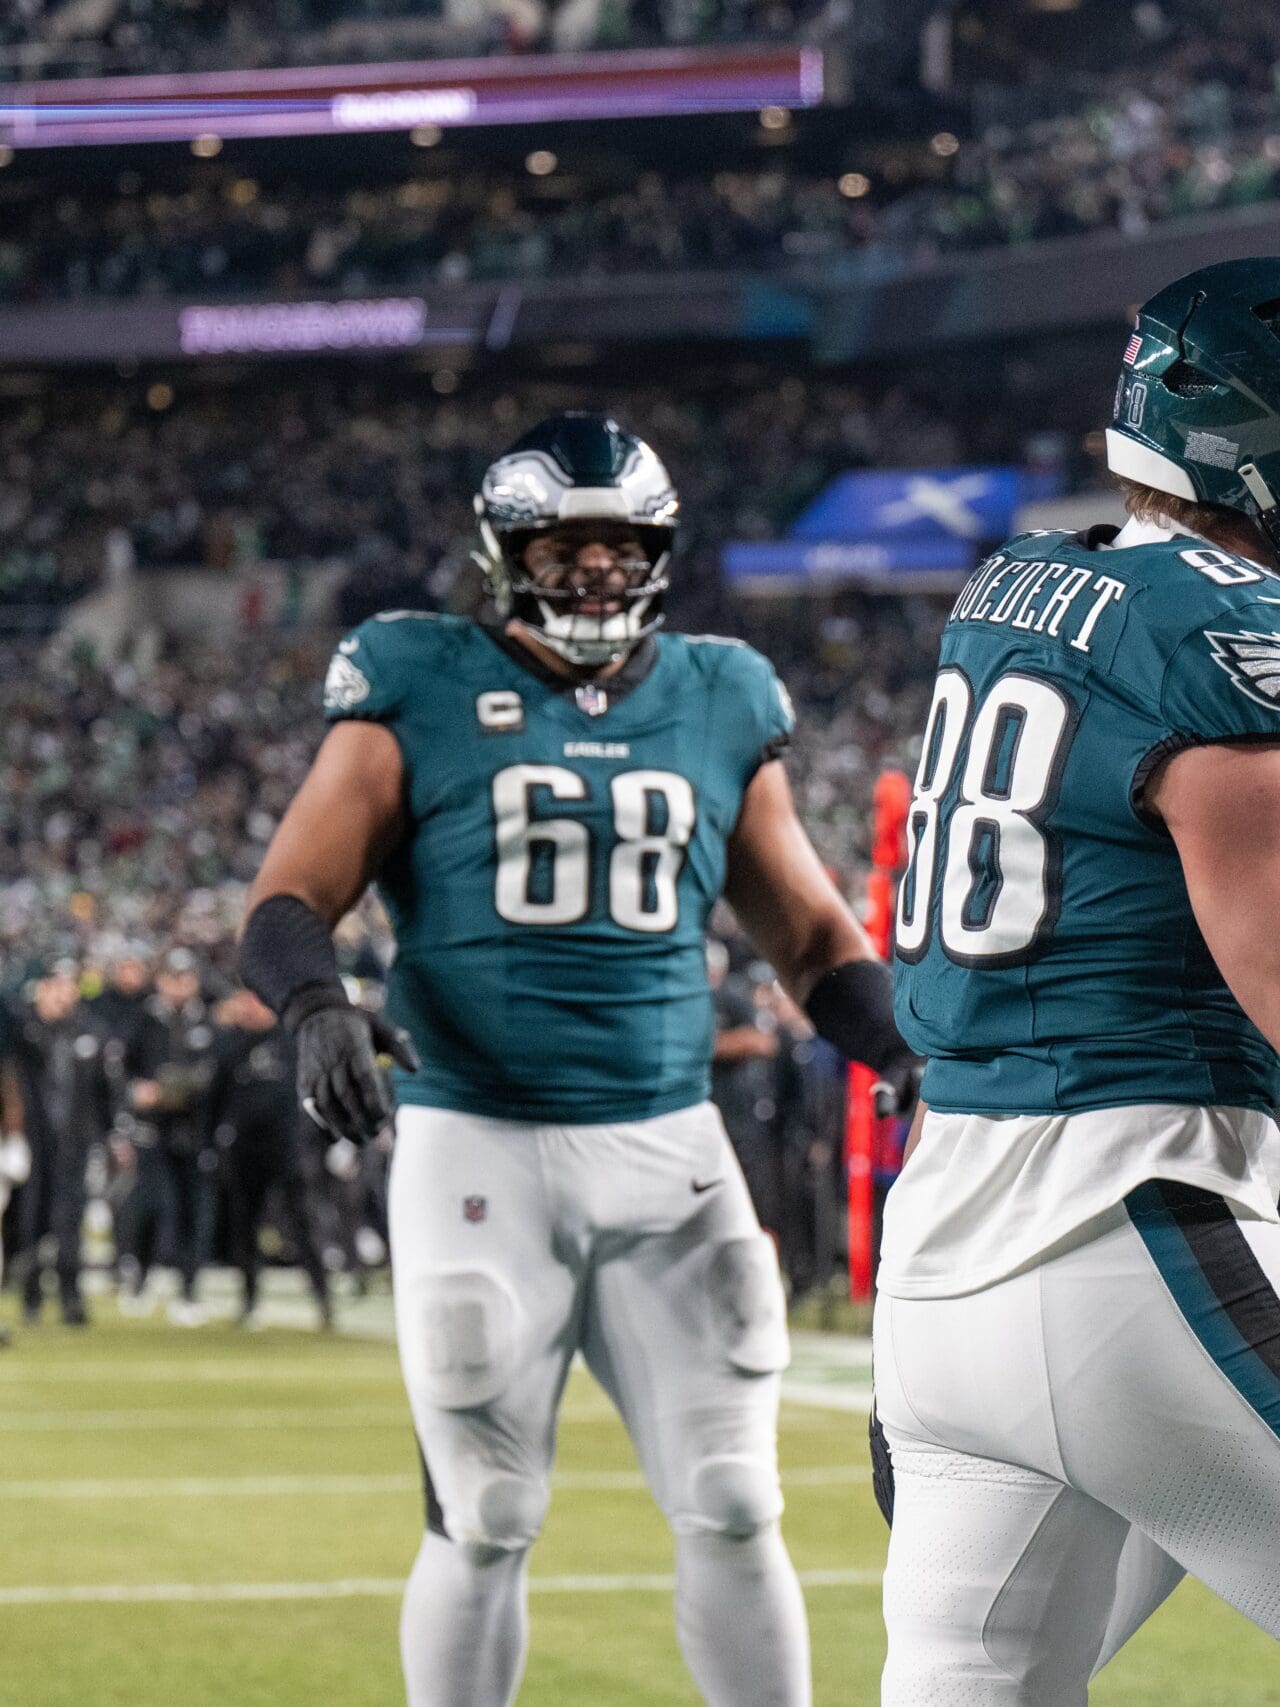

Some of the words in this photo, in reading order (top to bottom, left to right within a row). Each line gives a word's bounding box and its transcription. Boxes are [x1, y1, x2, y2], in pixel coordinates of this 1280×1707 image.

[476, 690, 523, 727] C
[492, 764, 696, 933] 68
[895, 666, 1072, 963] 88
